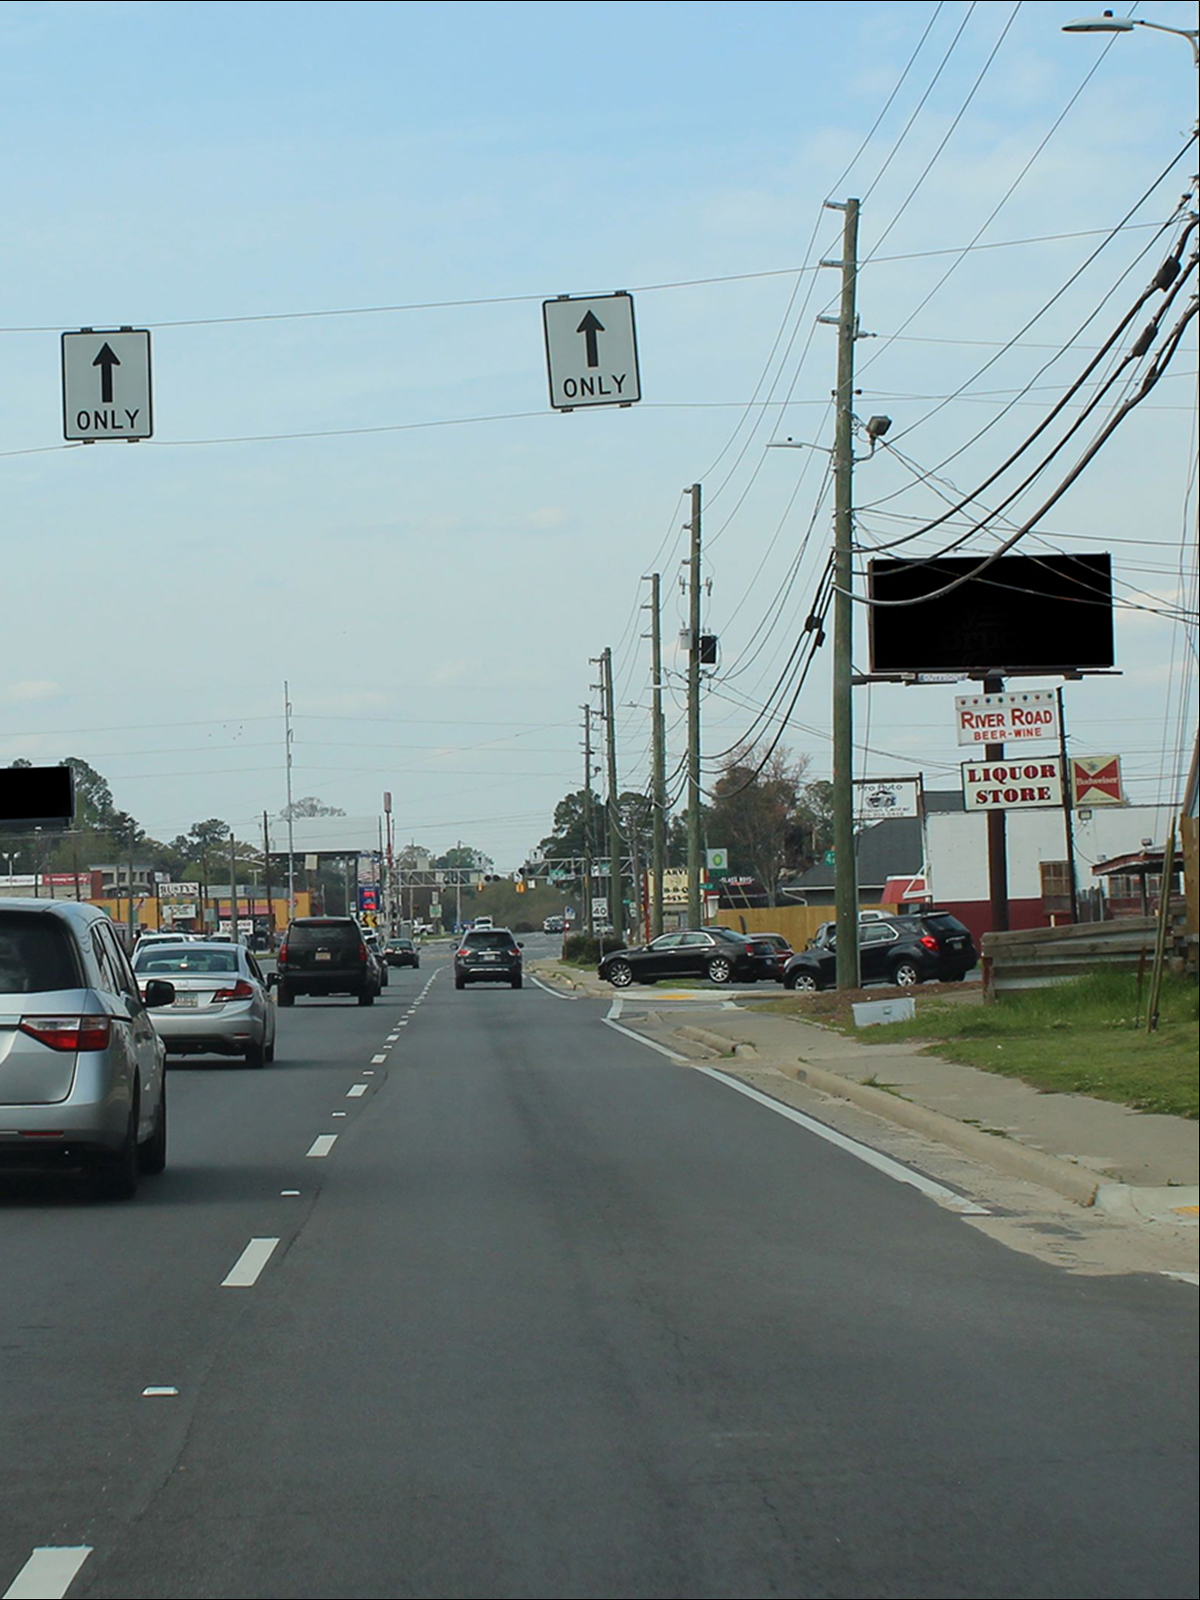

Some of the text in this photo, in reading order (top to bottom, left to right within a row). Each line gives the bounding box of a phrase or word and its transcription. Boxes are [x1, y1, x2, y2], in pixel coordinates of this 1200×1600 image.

[563, 373, 627, 399] ONLY
[76, 409, 141, 431] ONLY
[961, 708, 1053, 730] RIVER ROAD
[967, 764, 1057, 785] LIQUOR
[1076, 775, 1118, 786] Budweiser
[975, 786, 1051, 805] STORE
[593, 906, 607, 916] 40
